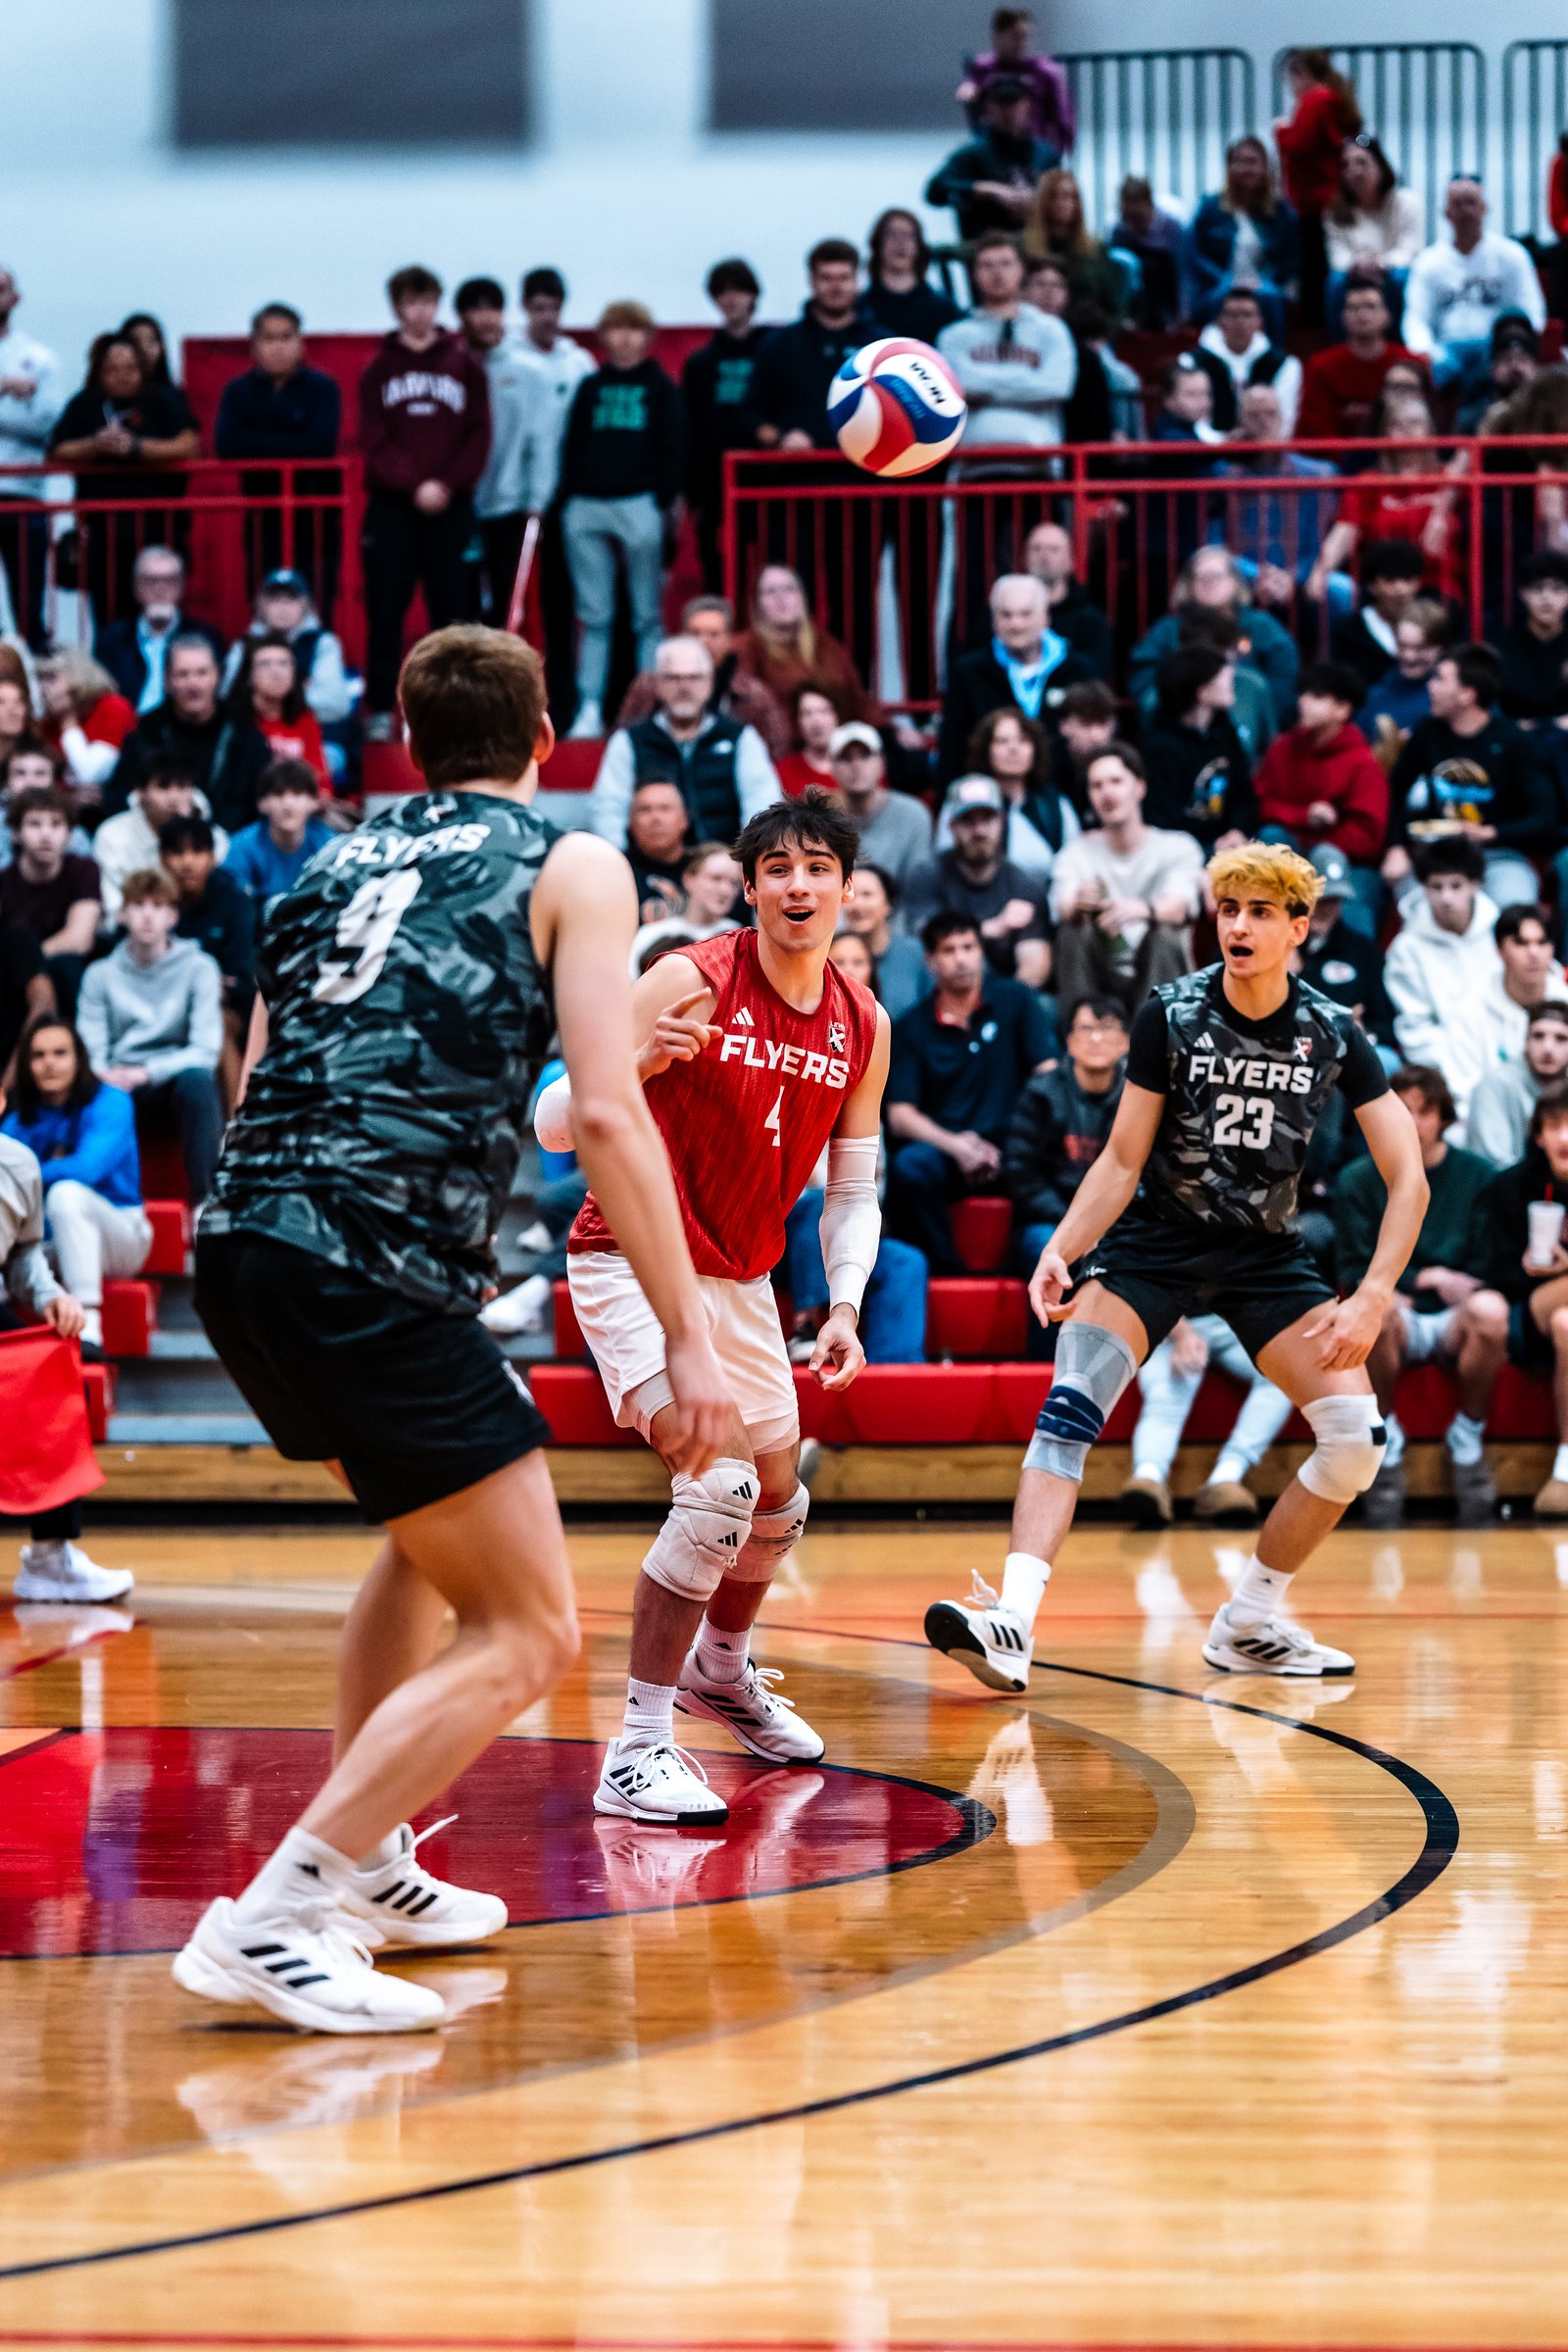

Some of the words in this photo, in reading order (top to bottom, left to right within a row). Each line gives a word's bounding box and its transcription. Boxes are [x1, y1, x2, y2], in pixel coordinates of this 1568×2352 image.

[311, 866, 422, 1004] 9
[719, 1033, 850, 1090] FLYERS
[1189, 1054, 1314, 1095] FLYERS
[763, 1085, 785, 1147] 4
[1213, 1093, 1275, 1151] 23
